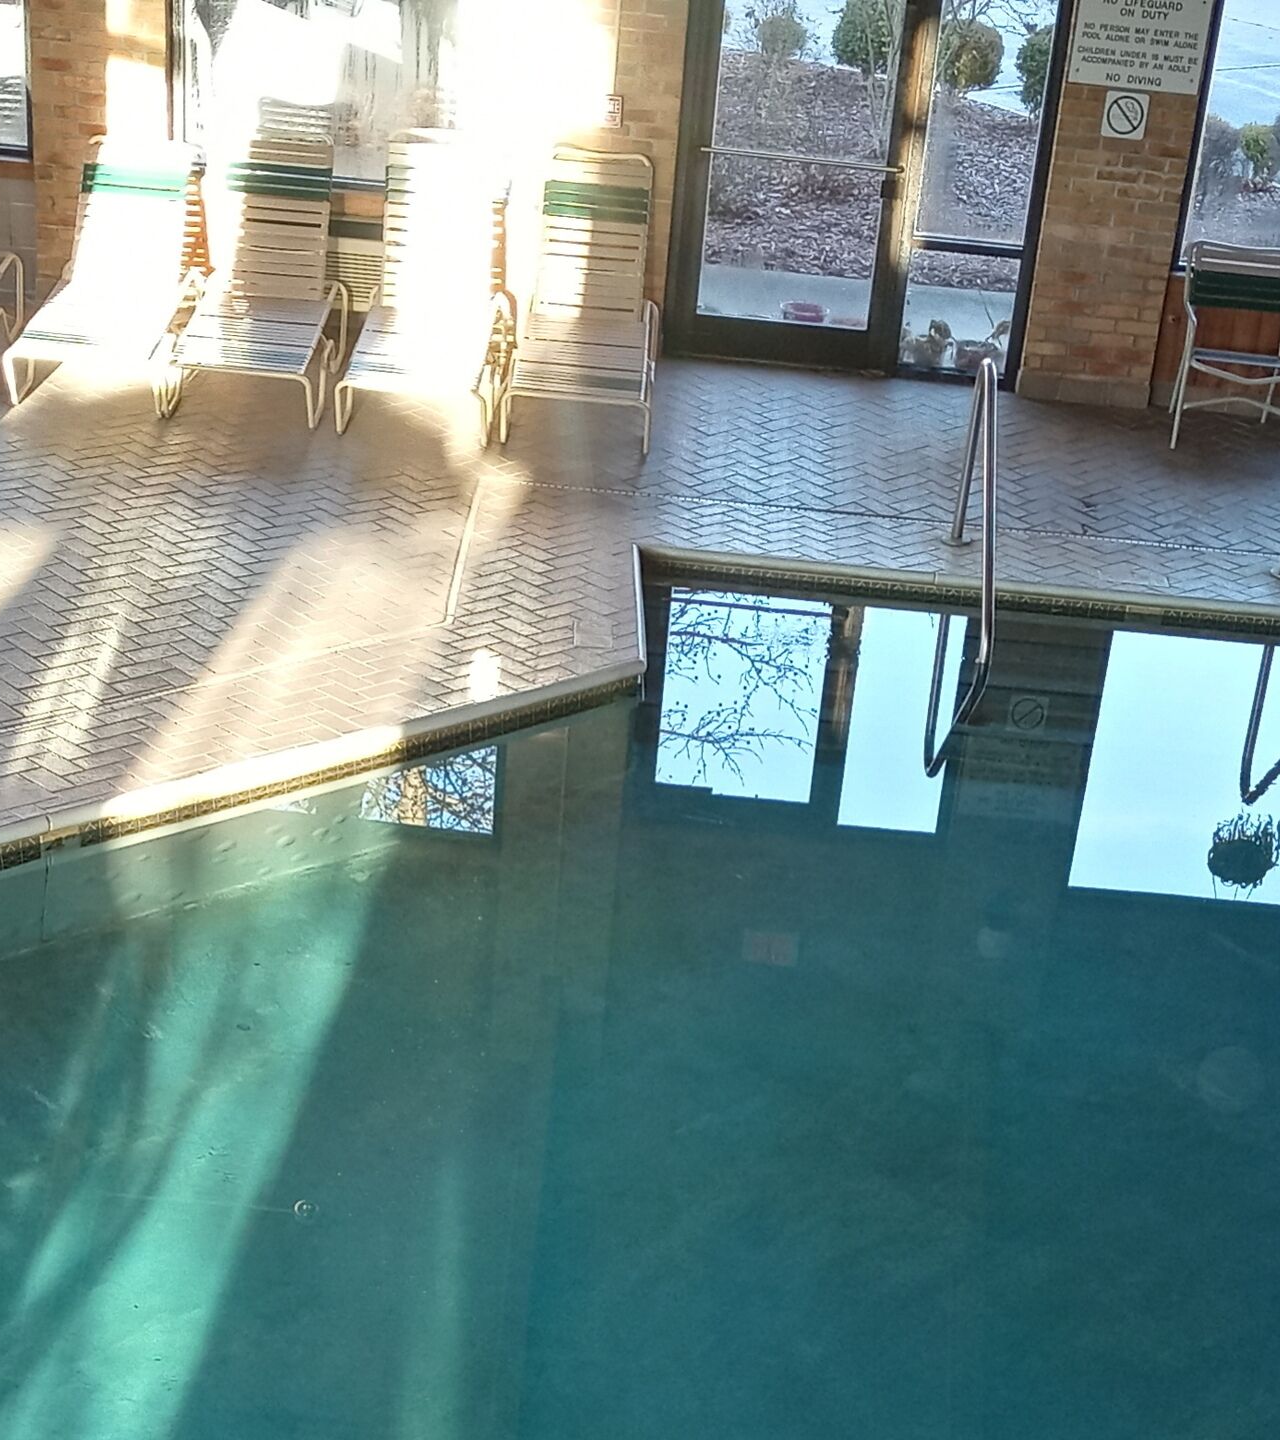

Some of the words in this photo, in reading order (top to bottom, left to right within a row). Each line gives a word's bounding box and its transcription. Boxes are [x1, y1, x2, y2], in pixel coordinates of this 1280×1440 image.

[1120, 7, 1135, 17] ON
[1141, 9, 1169, 20] DUTY
[1124, 0, 1183, 12] LIFEGUARD
[1081, 31, 1101, 40] POOL
[1105, 33, 1130, 43] ALONE
[1134, 36, 1146, 44] OR
[1150, 37, 1170, 47] SWIM
[1172, 40, 1198, 50] ALONE
[1084, 22, 1095, 30] NO
[1099, 23, 1130, 33] PERSON
[1134, 27, 1150, 35] MAY
[1153, 29, 1180, 39] ENTER
[1184, 32, 1199, 41] THE
[1077, 45, 1116, 56] CHILDREN
[1120, 50, 1147, 60] UNDER
[1163, 54, 1184, 63] MUST
[1187, 57, 1199, 66] BE
[1081, 55, 1136, 68] ACCOMPANIED
[1139, 60, 1150, 69] BY
[1152, 62, 1164, 71] AN
[1167, 64, 1193, 74] ADULT
[1105, 72, 1121, 82] NO
[1127, 75, 1162, 87] DIVING
